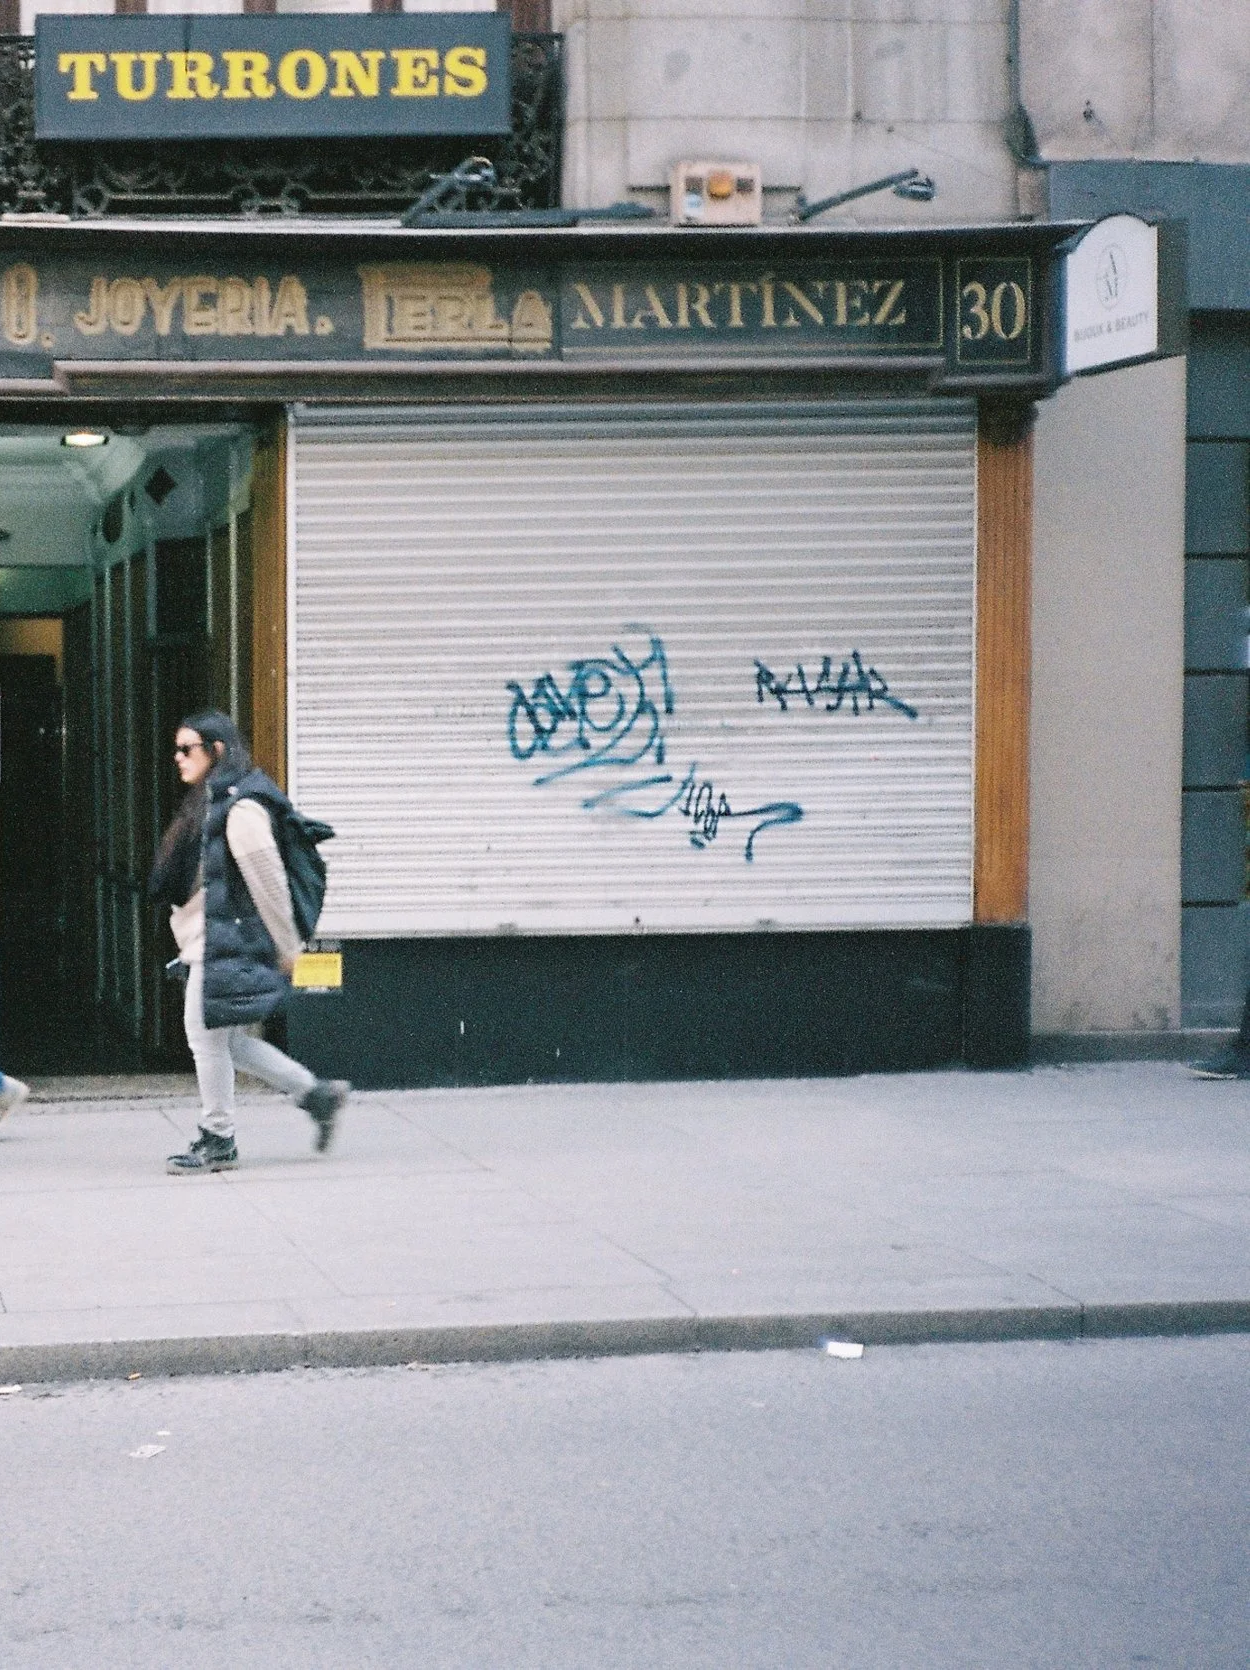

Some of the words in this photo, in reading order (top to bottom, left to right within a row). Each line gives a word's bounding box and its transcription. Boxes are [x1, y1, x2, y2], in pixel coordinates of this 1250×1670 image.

[58, 47, 488, 101] TURRONES
[571, 272, 907, 331] MARTÍNEZ
[960, 281, 1027, 341] 30
